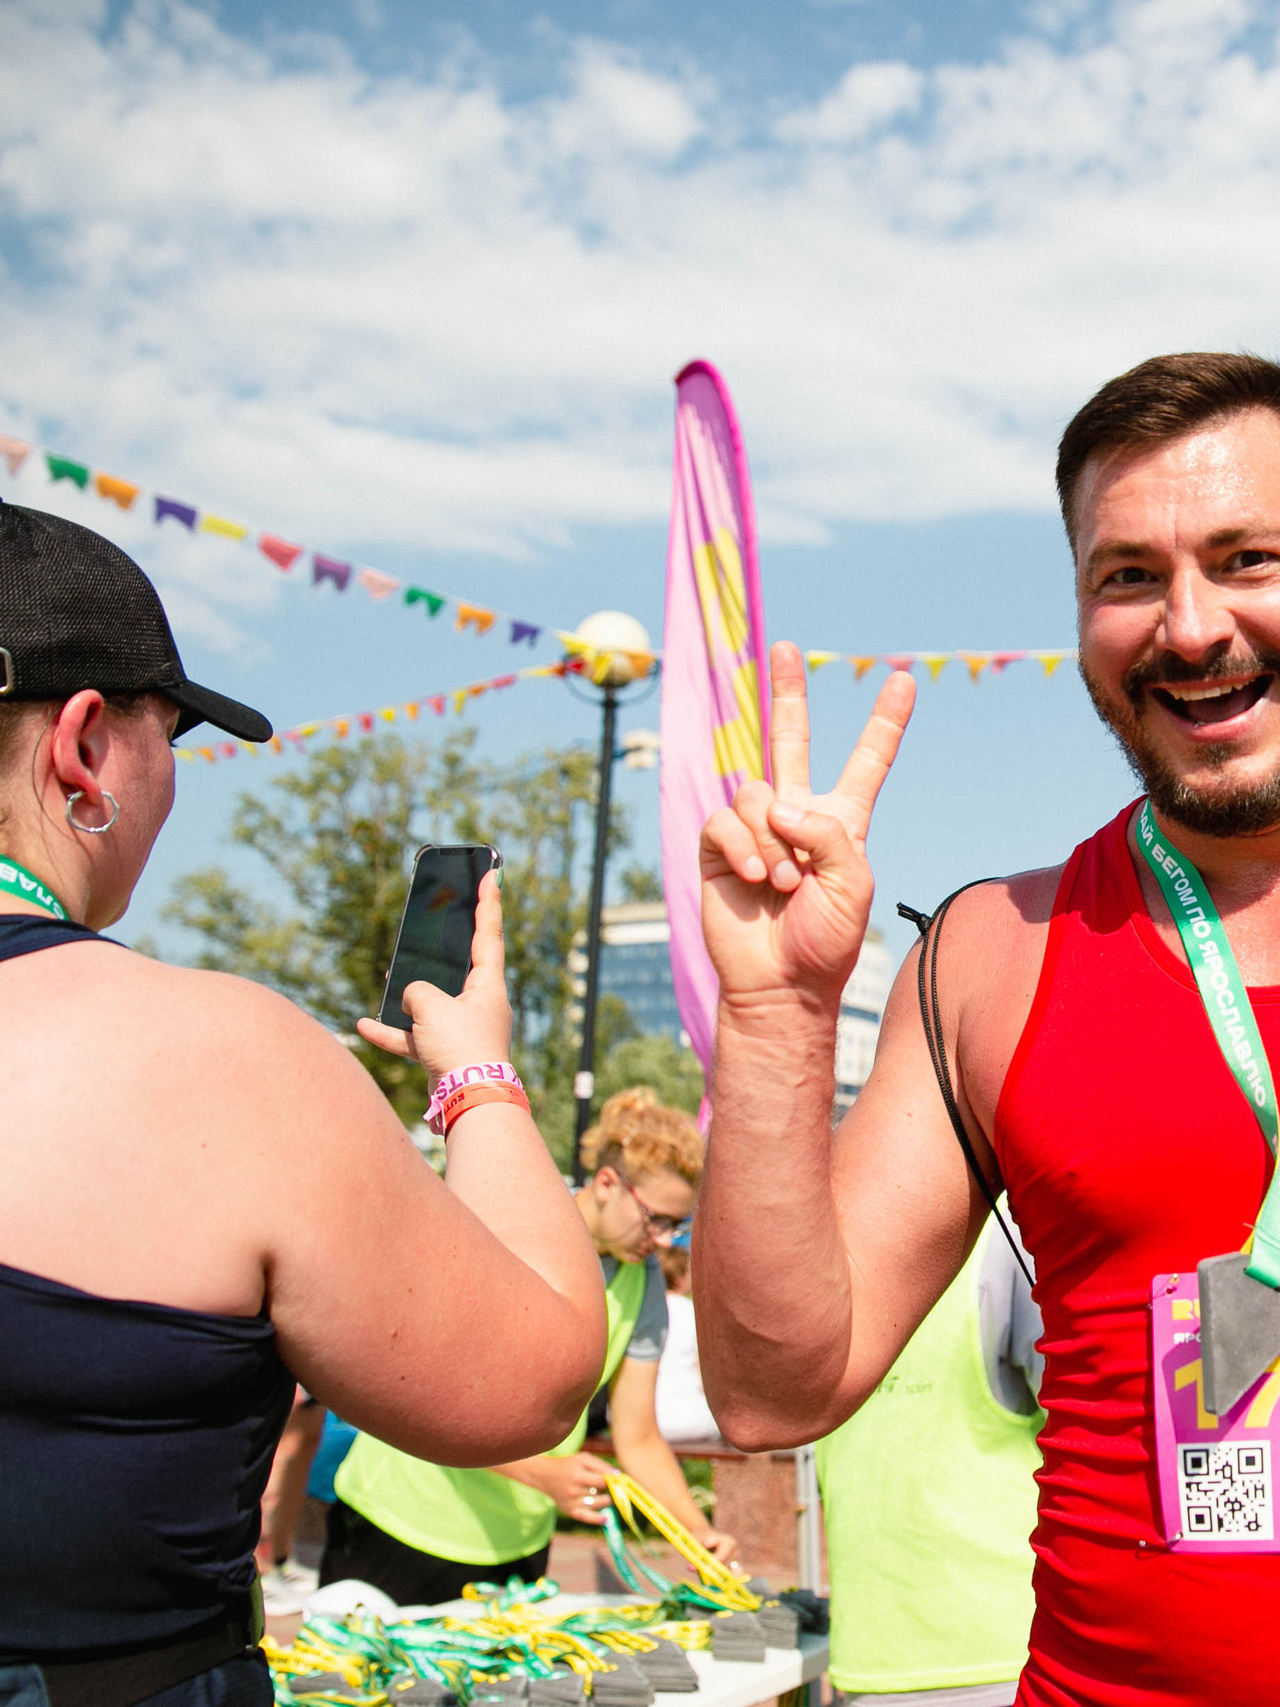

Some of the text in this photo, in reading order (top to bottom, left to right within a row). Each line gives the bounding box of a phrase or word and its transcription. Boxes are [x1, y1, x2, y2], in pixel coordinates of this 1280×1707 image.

[1151, 843, 1198, 906] БЕГОМ
[1186, 906, 1212, 939] ПО
[1198, 940, 1267, 1107] ЯРОСЛАВЛЮ
[436, 1064, 505, 1101] RUTS
[443, 1092, 465, 1112] RUT
